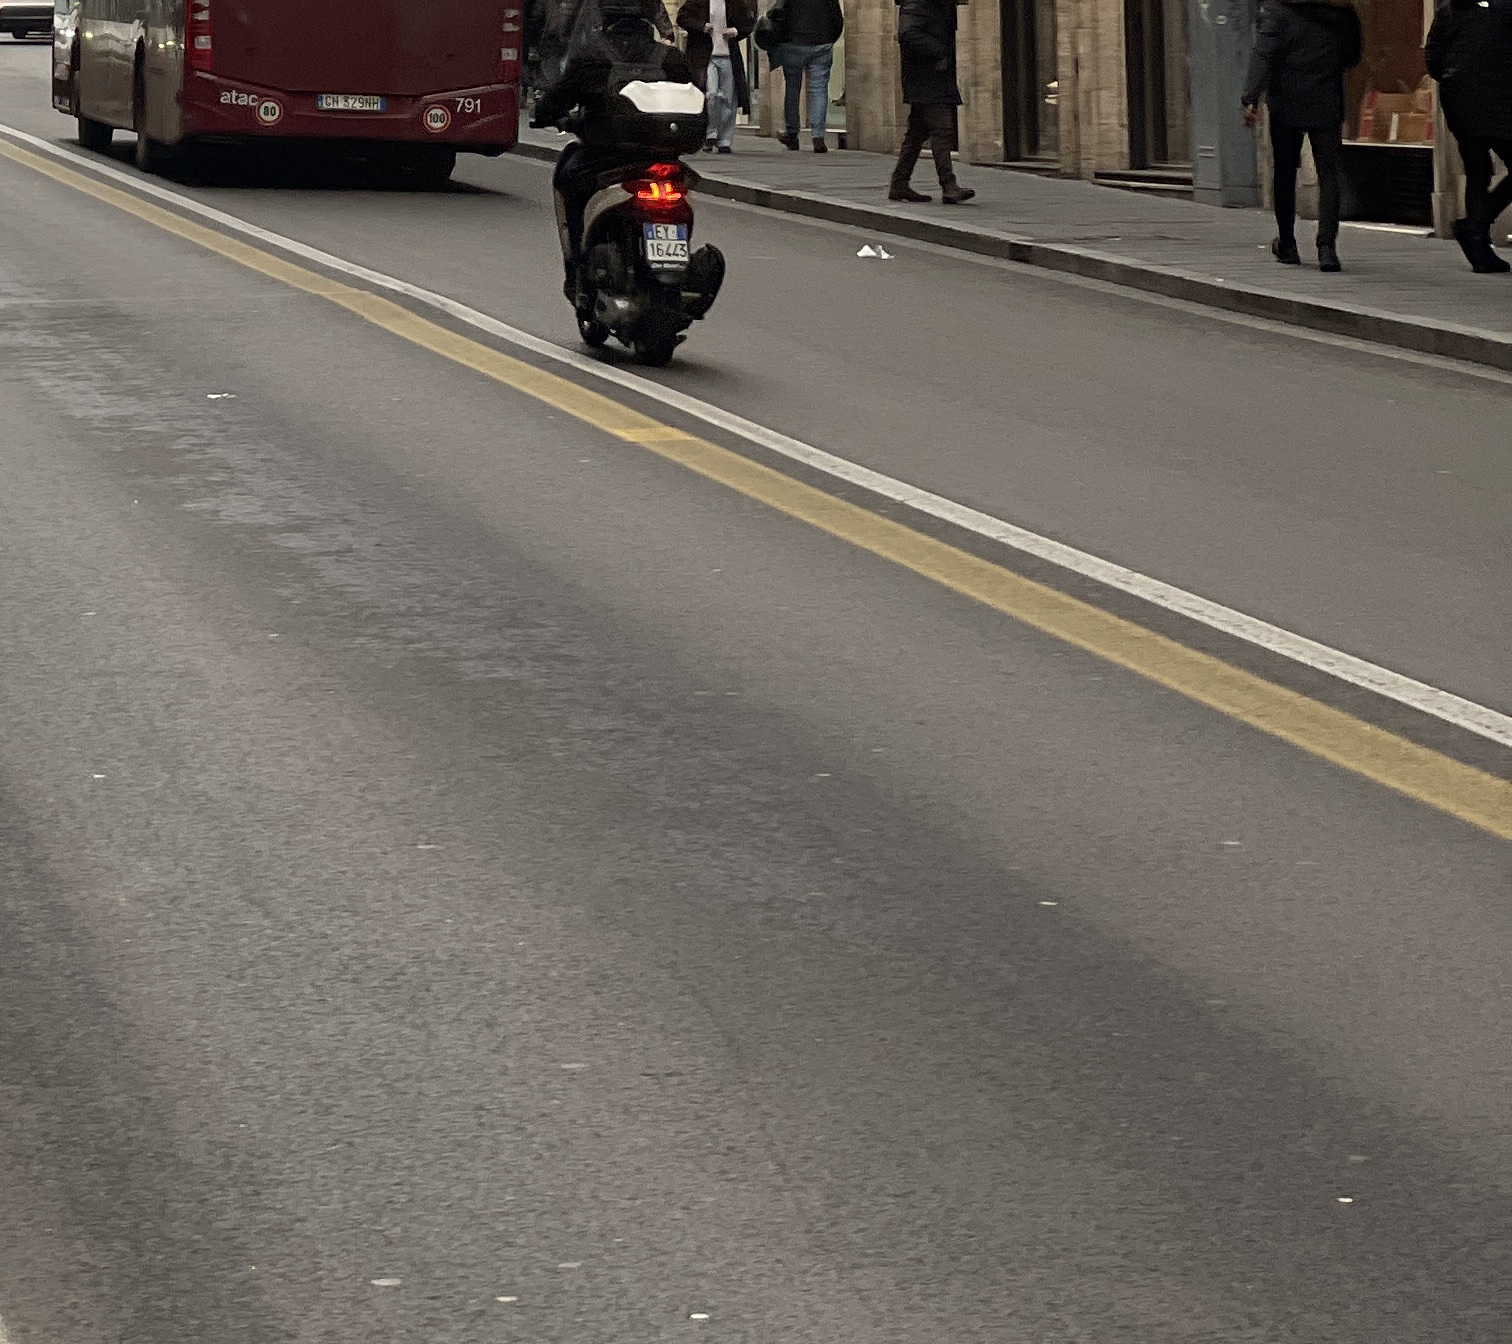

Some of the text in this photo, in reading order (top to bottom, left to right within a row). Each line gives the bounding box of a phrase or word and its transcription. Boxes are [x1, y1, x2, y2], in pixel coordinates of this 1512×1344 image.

[219, 89, 258, 107] atac
[455, 97, 482, 114] 791
[263, 105, 277, 118] 80
[429, 112, 446, 124] 100
